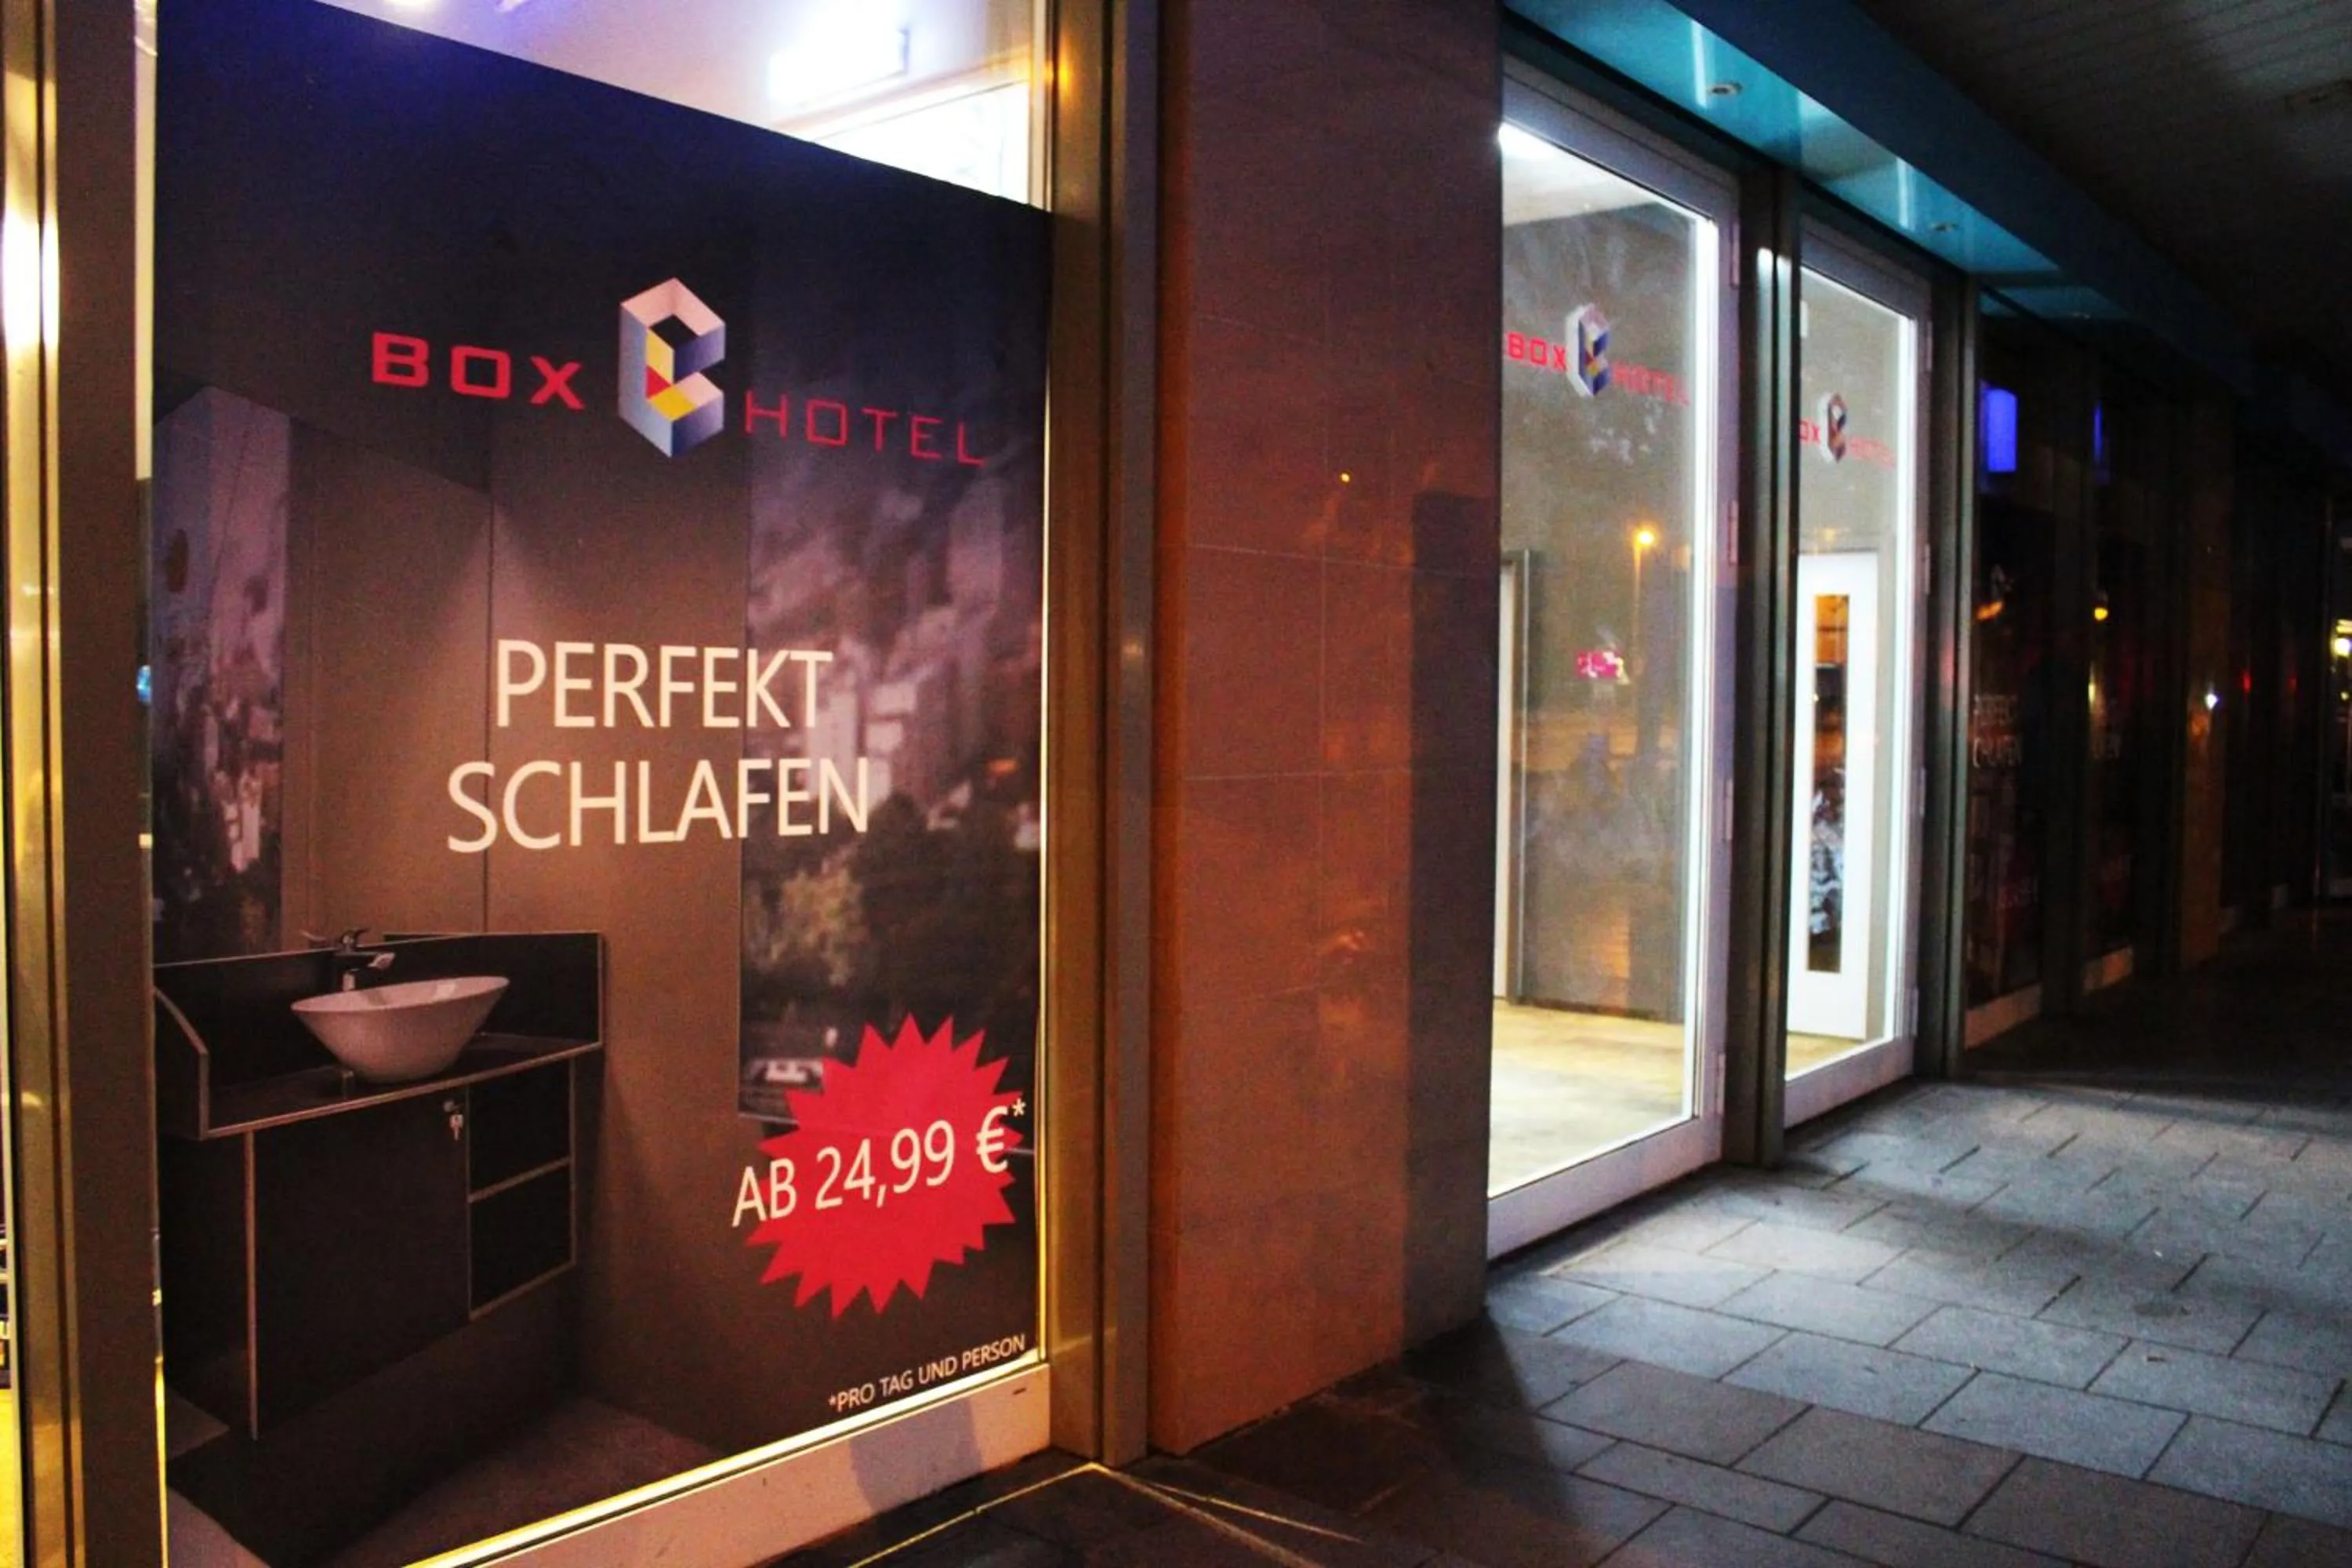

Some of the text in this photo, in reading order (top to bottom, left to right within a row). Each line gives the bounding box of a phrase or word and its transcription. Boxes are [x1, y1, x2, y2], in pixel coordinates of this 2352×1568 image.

[1506, 332, 1566, 372] BOX
[371, 332, 987, 467] BOX HOTEL
[496, 639, 833, 729] PERFEKT
[447, 757, 869, 854] SCHLAFEN
[731, 1158, 797, 1228] AB
[815, 1120, 955, 1210] 24,99
[880, 1370, 913, 1396] TAG
[918, 1357, 958, 1384] UND
[962, 1334, 1025, 1370] PERSON
